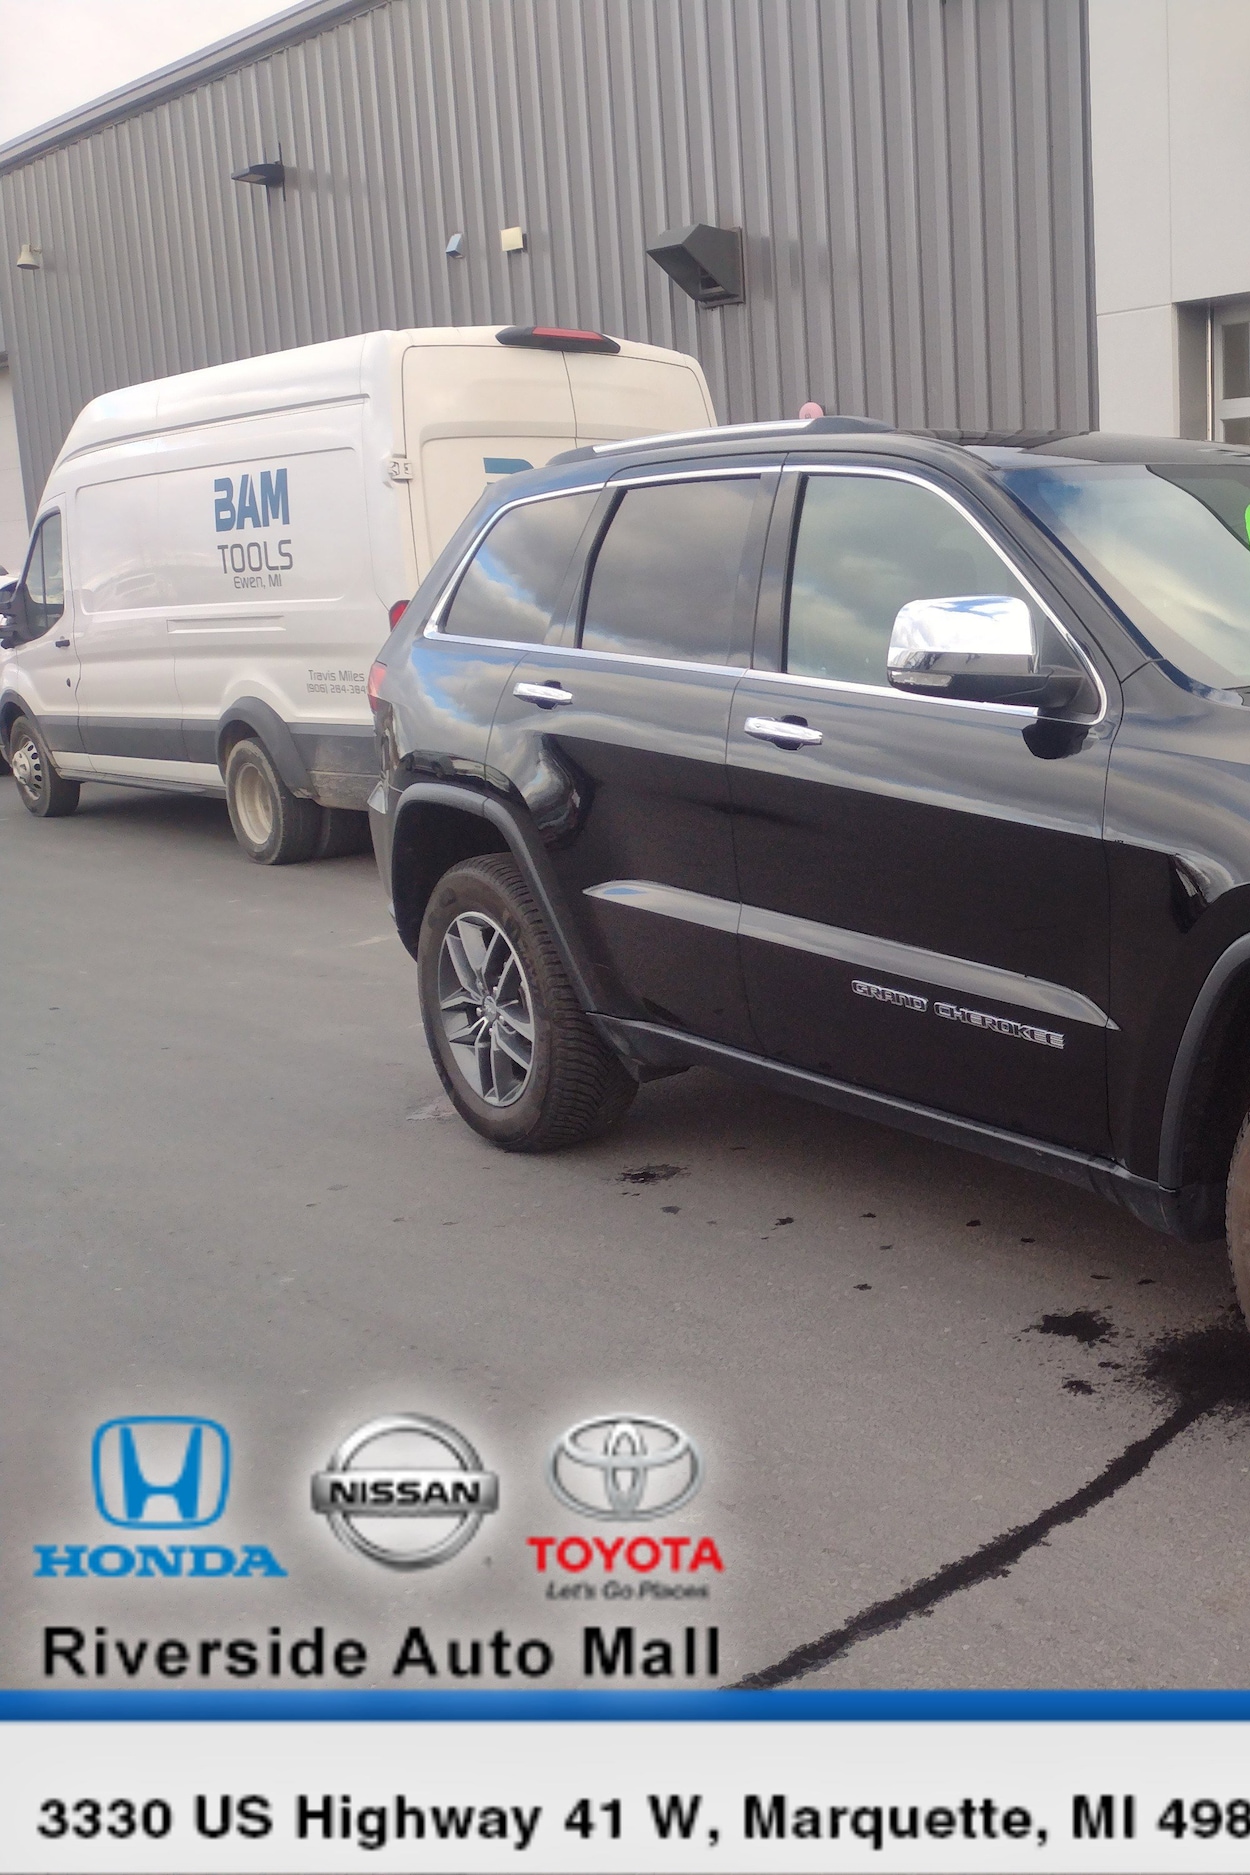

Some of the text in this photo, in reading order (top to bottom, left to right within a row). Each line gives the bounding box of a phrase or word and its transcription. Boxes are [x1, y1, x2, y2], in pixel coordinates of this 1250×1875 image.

[214, 468, 290, 532] BAM
[217, 539, 293, 574] TOOLS
[233, 573, 282, 589] Ewen, MI
[308, 669, 365, 682] Travis Miles
[851, 979, 1065, 1050] GRAND CHEROKEE
